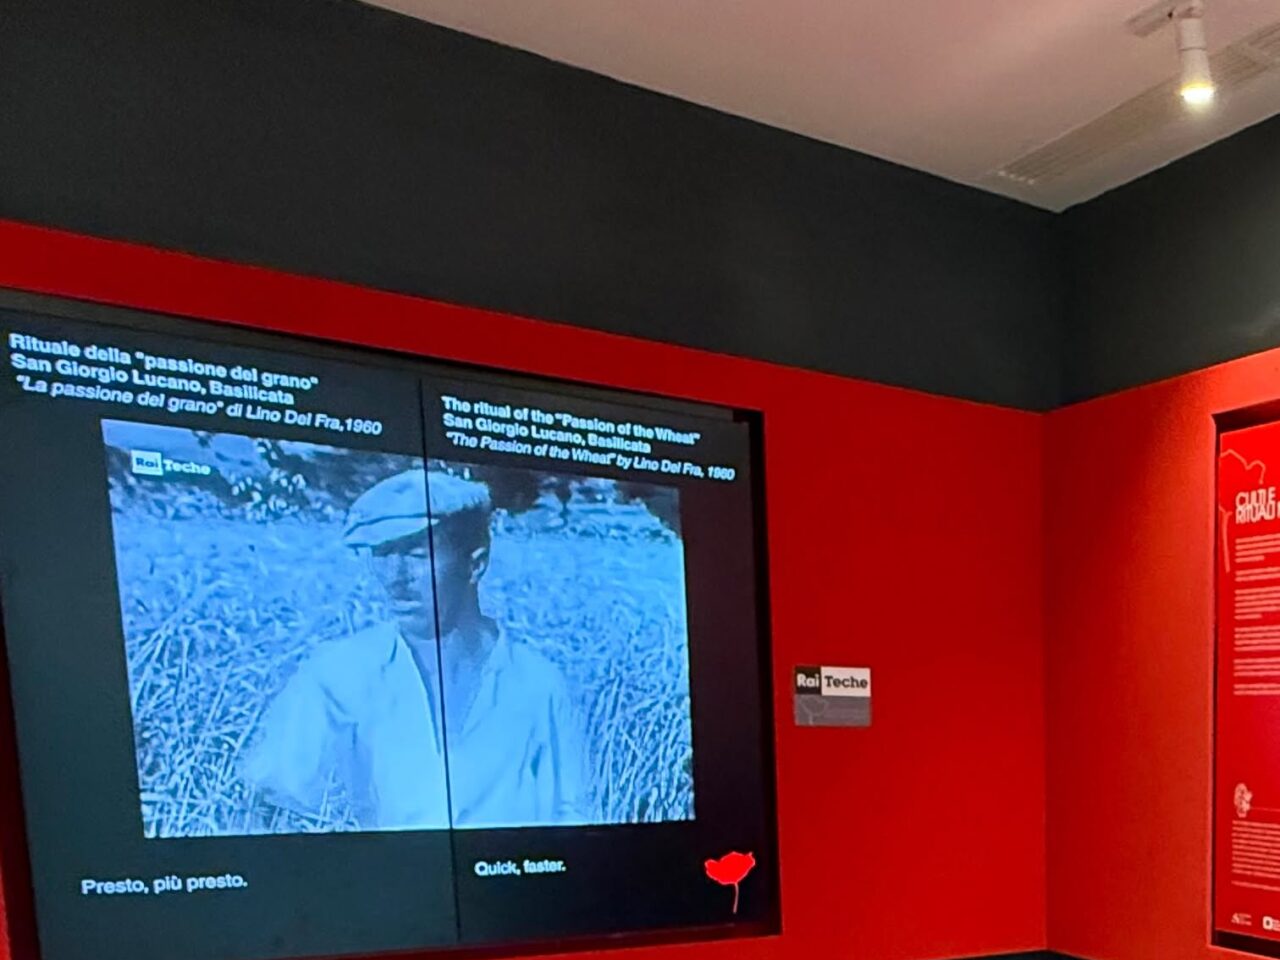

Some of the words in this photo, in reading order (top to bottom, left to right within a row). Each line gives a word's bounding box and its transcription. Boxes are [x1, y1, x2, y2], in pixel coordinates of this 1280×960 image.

[9, 333, 81, 357] Rituale
[83, 345, 131, 365] della
[230, 365, 258, 382] del
[10, 353, 52, 372] San
[55, 359, 129, 383] Giorgio
[132, 369, 207, 395] Lucano,
[209, 379, 295, 406] Basilicata
[51, 382, 134, 404] passione
[136, 391, 165, 408] del
[226, 402, 242, 417] di
[245, 405, 281, 422] Lino
[284, 410, 312, 426] Del
[441, 395, 471, 413] The
[473, 401, 511, 418] ritual
[513, 407, 529, 420] of
[531, 409, 554, 425] the
[617, 423, 632, 435] of
[633, 424, 654, 439] the
[443, 413, 473, 429] San
[475, 417, 529, 438] Giorgio
[531, 425, 586, 446] Lucano,
[587, 433, 652, 454] Basilicata
[136, 457, 158, 468] Rai
[163, 459, 211, 475] Teche
[480, 435, 532, 455] Passion
[534, 444, 548, 456] of
[549, 445, 570, 460] the
[616, 453, 632, 470] by
[633, 456, 659, 471] Lino
[661, 460, 681, 474] Del
[683, 462, 705, 478] Fra,
[708, 465, 736, 481] 1960
[796, 673, 820, 688] Rai
[824, 675, 868, 689] Teche
[81, 878, 149, 895] Presto,
[153, 875, 182, 894] più
[186, 873, 248, 893] presto.
[474, 860, 521, 876] Quick,
[523, 859, 567, 873] faster.
